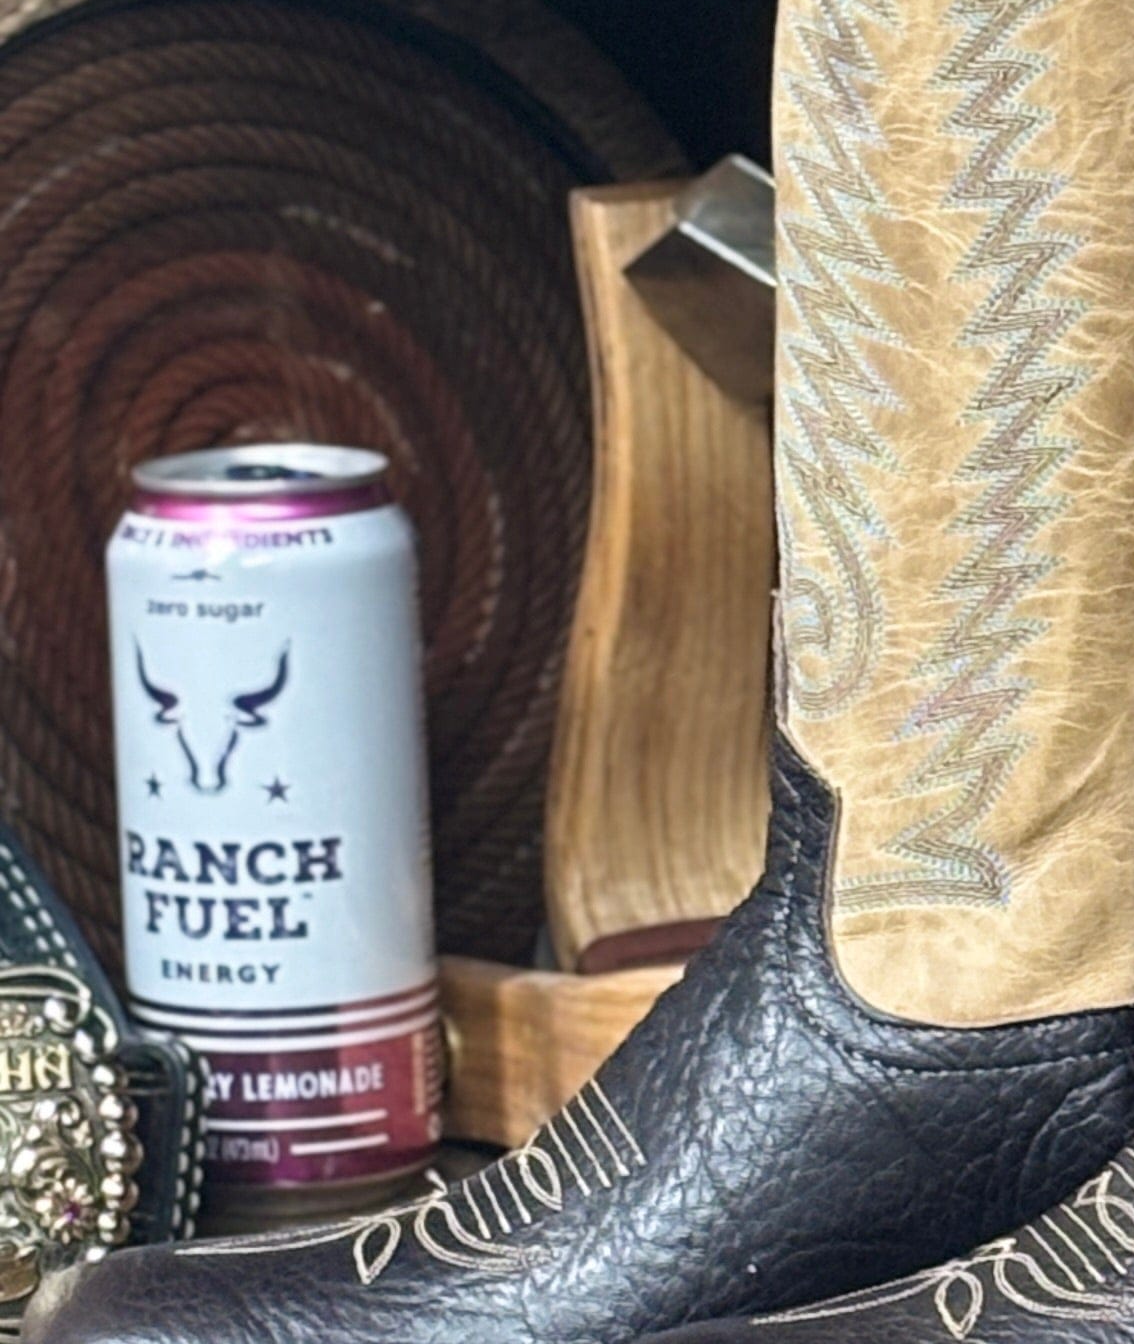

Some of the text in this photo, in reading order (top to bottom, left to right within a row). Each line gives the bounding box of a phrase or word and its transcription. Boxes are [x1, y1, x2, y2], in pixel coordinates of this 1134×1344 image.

[146, 599, 265, 623] zero sugar
[126, 830, 343, 886] RANCH
[144, 890, 309, 941] FUEL
[161, 958, 281, 985] ENERGY
[241, 1062, 386, 1102] LEMONADE
